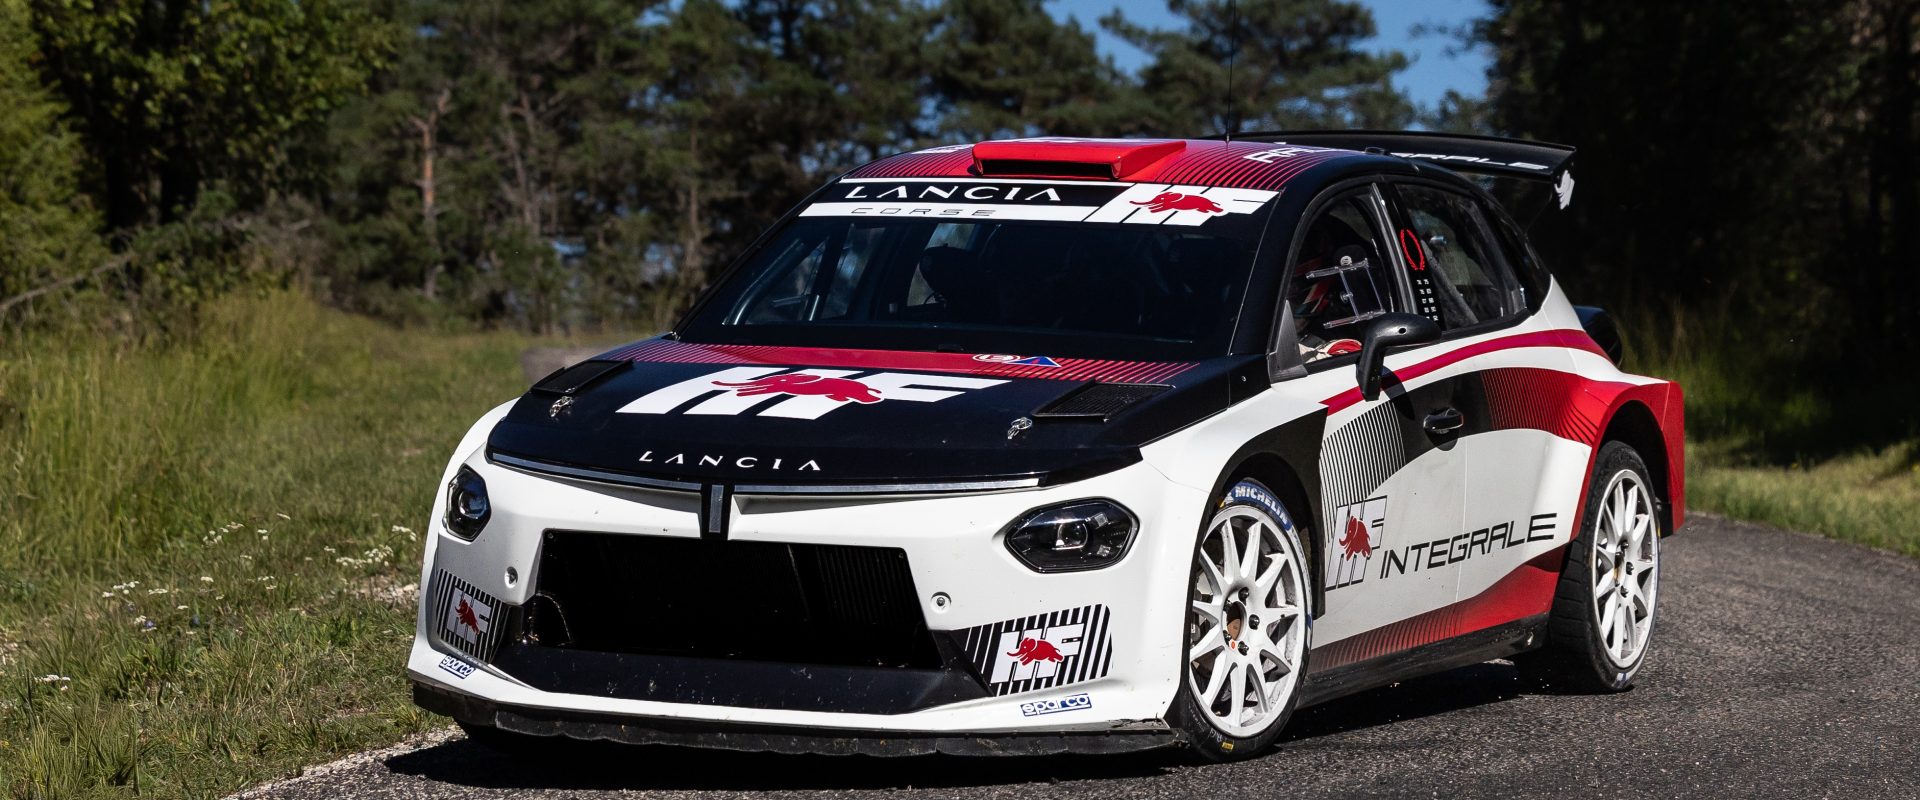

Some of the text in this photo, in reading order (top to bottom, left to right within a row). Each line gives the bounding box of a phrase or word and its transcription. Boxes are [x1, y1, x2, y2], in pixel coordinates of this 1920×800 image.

[844, 185, 1062, 203] LANCIA
[851, 207, 996, 217] CORSE
[638, 450, 822, 472] LANCIA
[1235, 486, 1289, 524] MICHELIN
[1379, 512, 1558, 580] INTEGRALE
[441, 656, 475, 676] sparco
[1022, 695, 1089, 715] sparco
